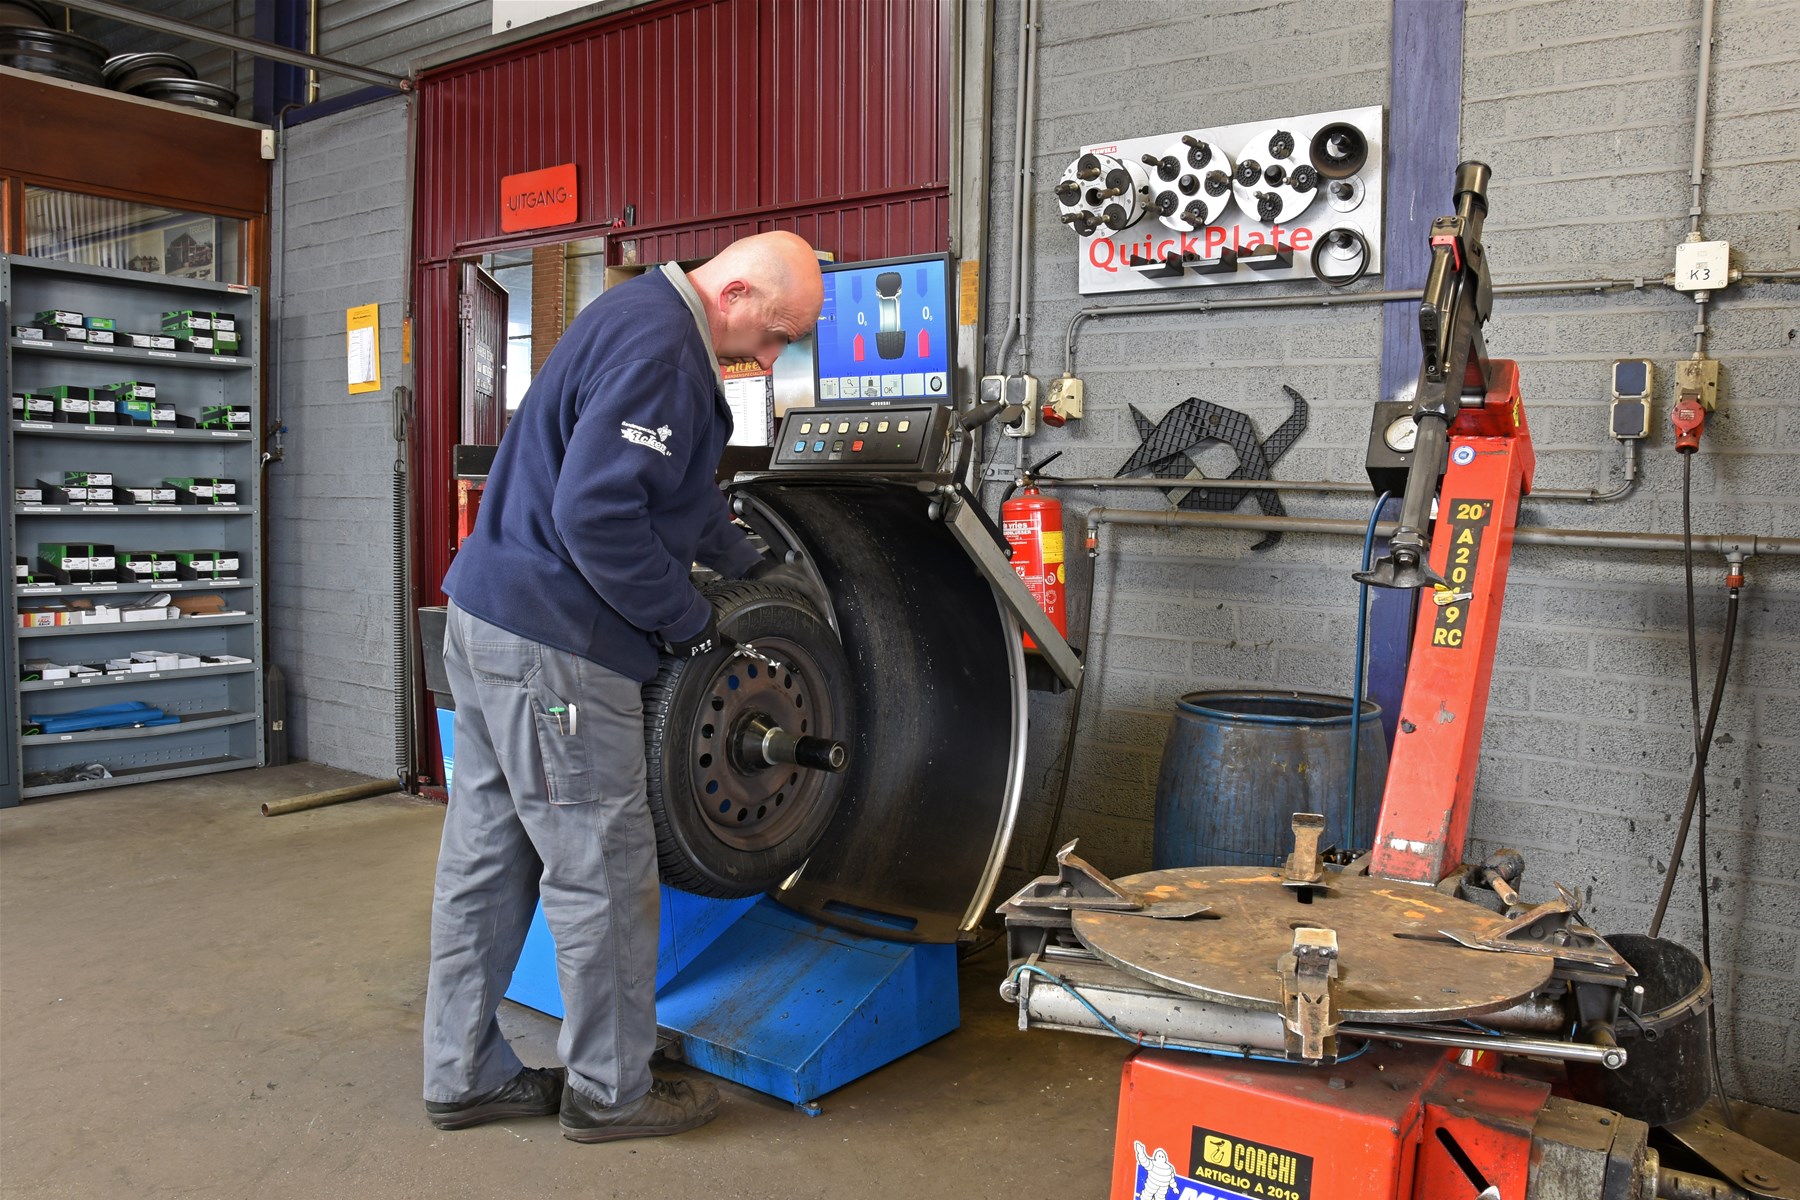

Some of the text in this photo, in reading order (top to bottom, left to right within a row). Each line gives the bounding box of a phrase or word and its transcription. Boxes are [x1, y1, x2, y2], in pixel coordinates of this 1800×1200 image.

[509, 187, 567, 211] UITGANG
[1089, 224, 1313, 272] QuickPlate
[1433, 628, 1462, 646] RC
[1234, 1143, 1297, 1186] CORGHI
[1195, 1166, 1251, 1190] ARTIGLIO
[1254, 1183, 1264, 1194] A
[1267, 1186, 1300, 1200] 2019
